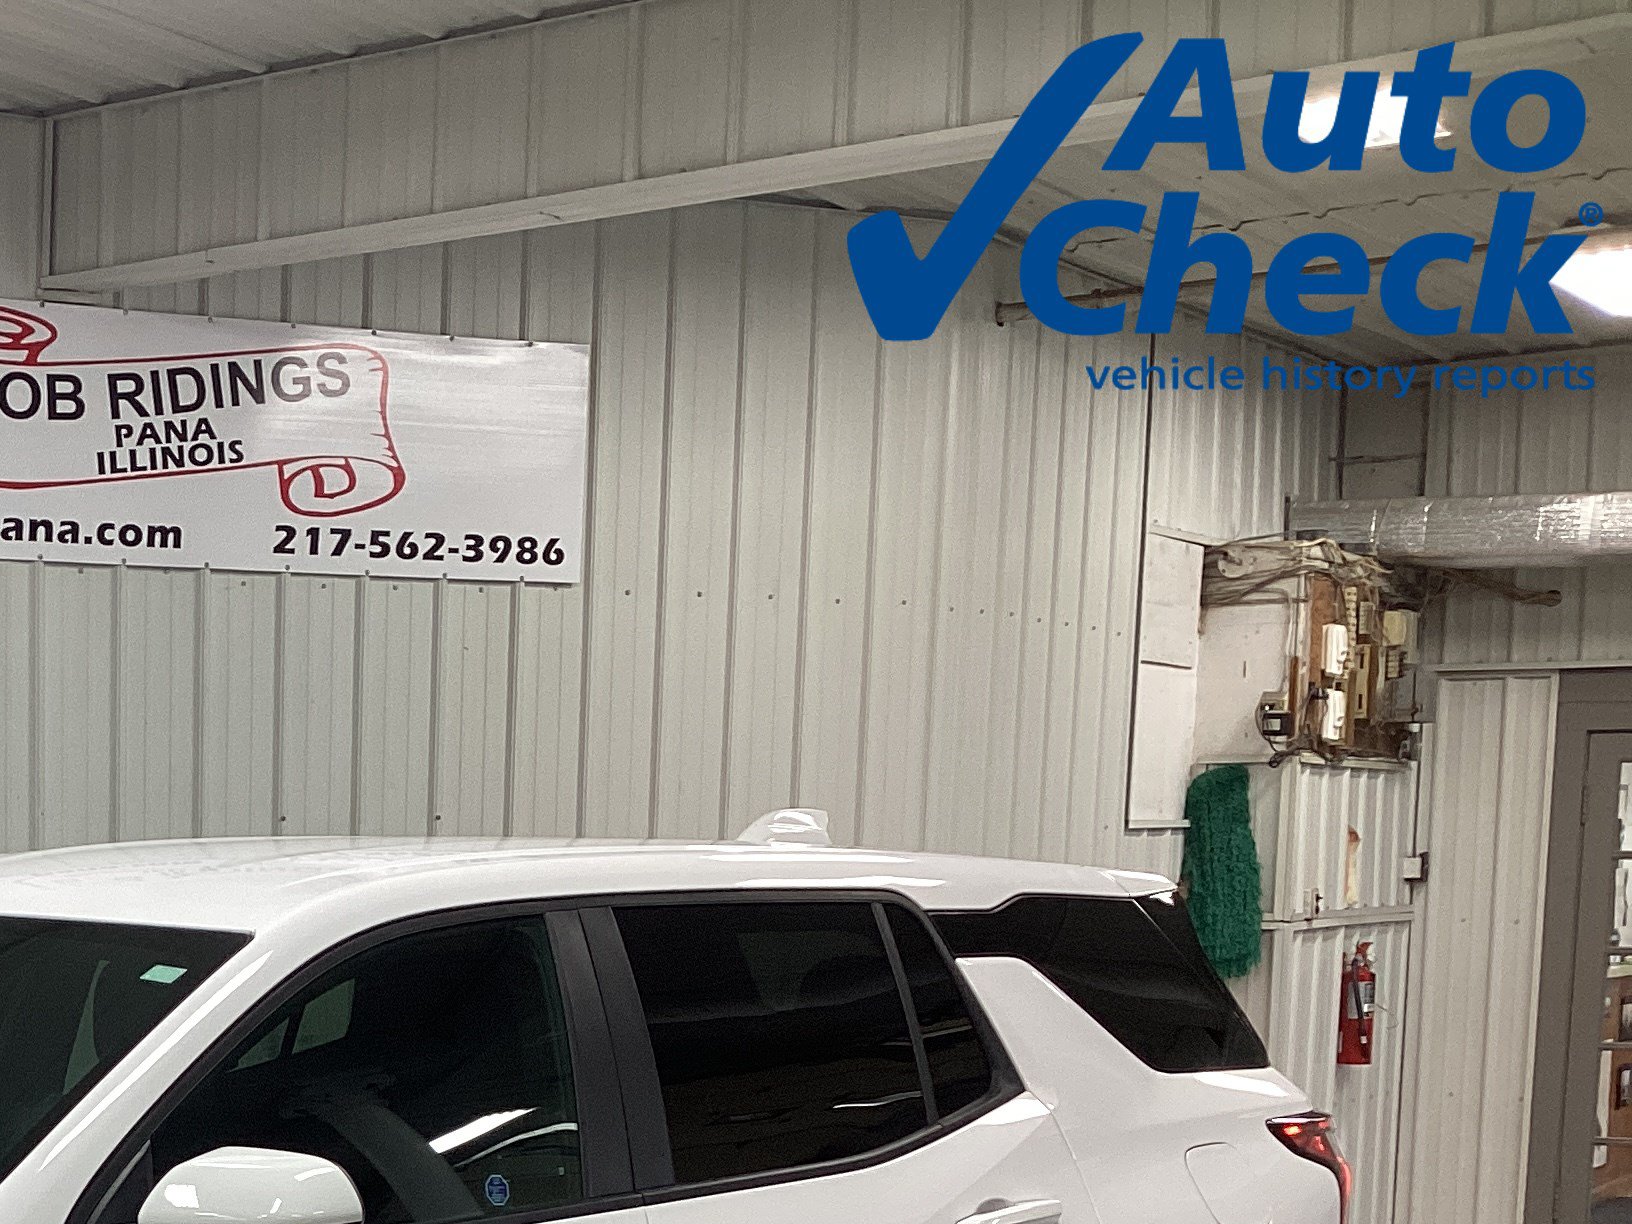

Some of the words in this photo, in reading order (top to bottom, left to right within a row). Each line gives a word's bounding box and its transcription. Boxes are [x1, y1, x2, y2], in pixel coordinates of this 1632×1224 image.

[106, 351, 351, 420] RIDINGS
[114, 417, 217, 448] PANA
[96, 439, 244, 475] ILLINOIS
[272, 524, 565, 566] 217-562-3986
